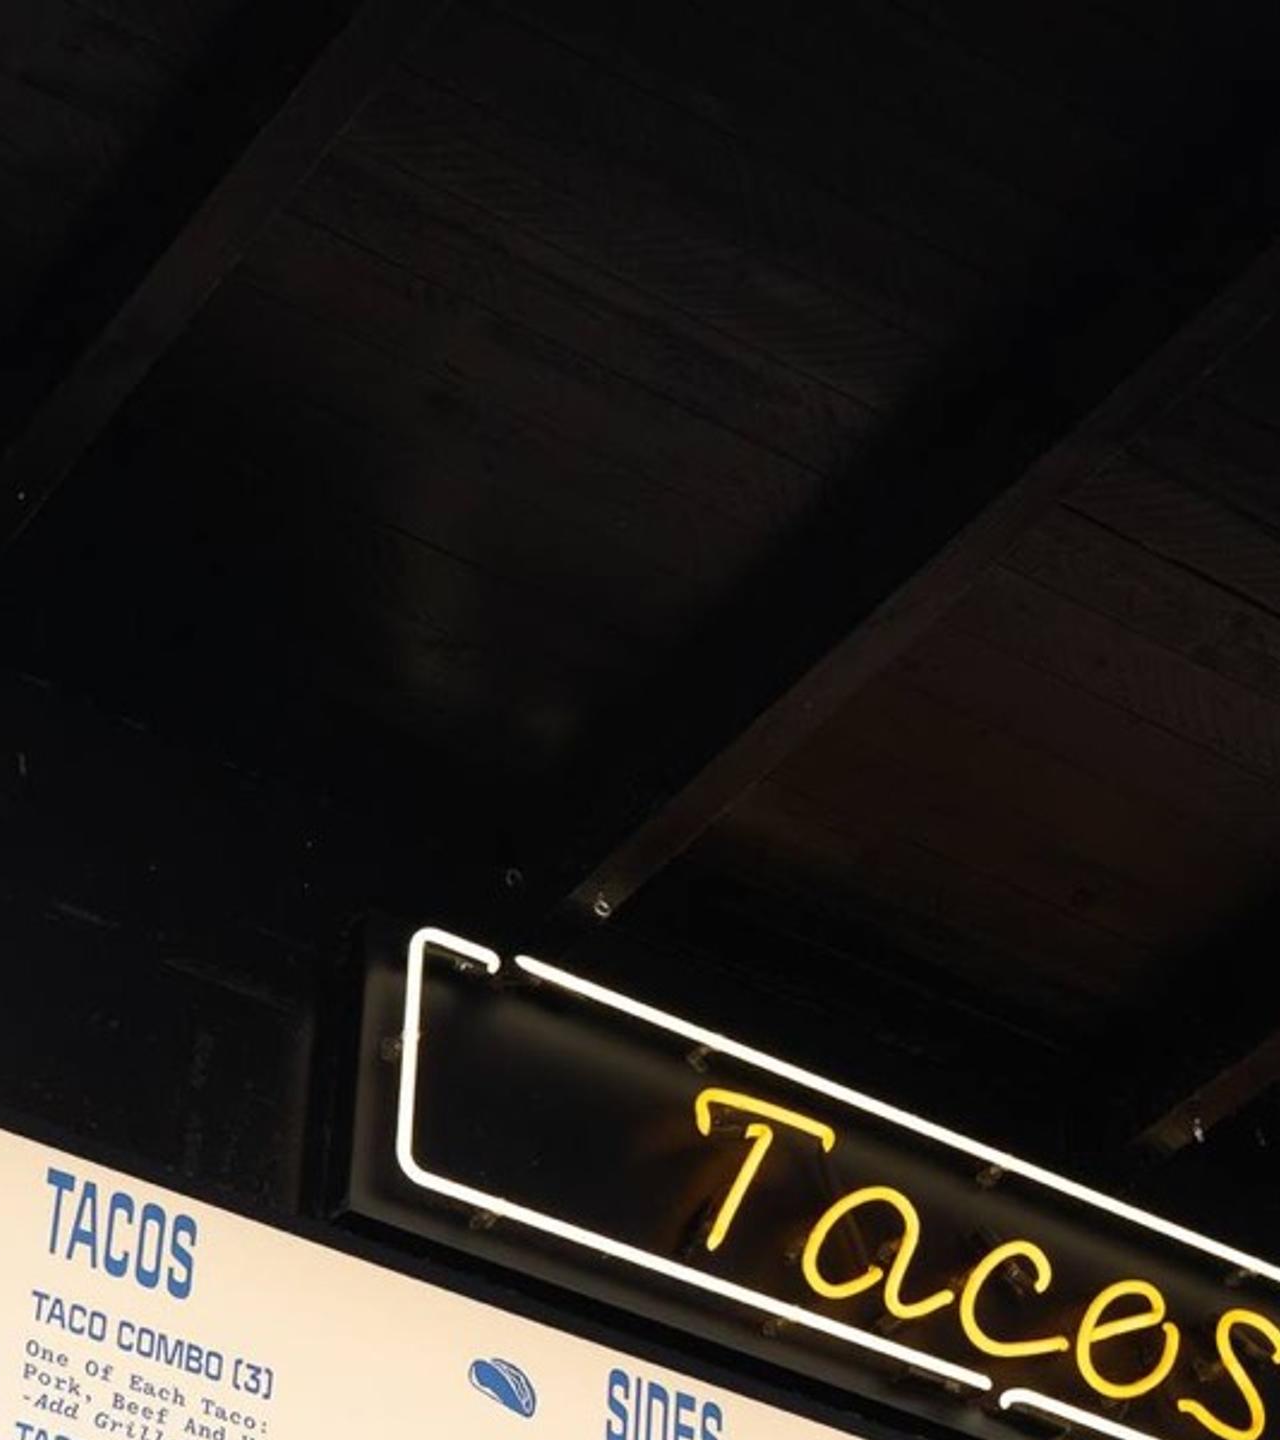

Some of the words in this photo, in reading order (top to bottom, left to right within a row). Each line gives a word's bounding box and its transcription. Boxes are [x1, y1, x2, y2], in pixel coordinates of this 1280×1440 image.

[46, 1166, 198, 1300] TACOS
[31, 1289, 108, 1343] TACO
[116, 1320, 224, 1382] COMBO
[22, 1362, 92, 1404] Pork,
[111, 1391, 169, 1425] Beef
[25, 1339, 69, 1368] One
[84, 1359, 114, 1382] Of
[128, 1373, 186, 1408] Each
[200, 1397, 267, 1434] Taco:
